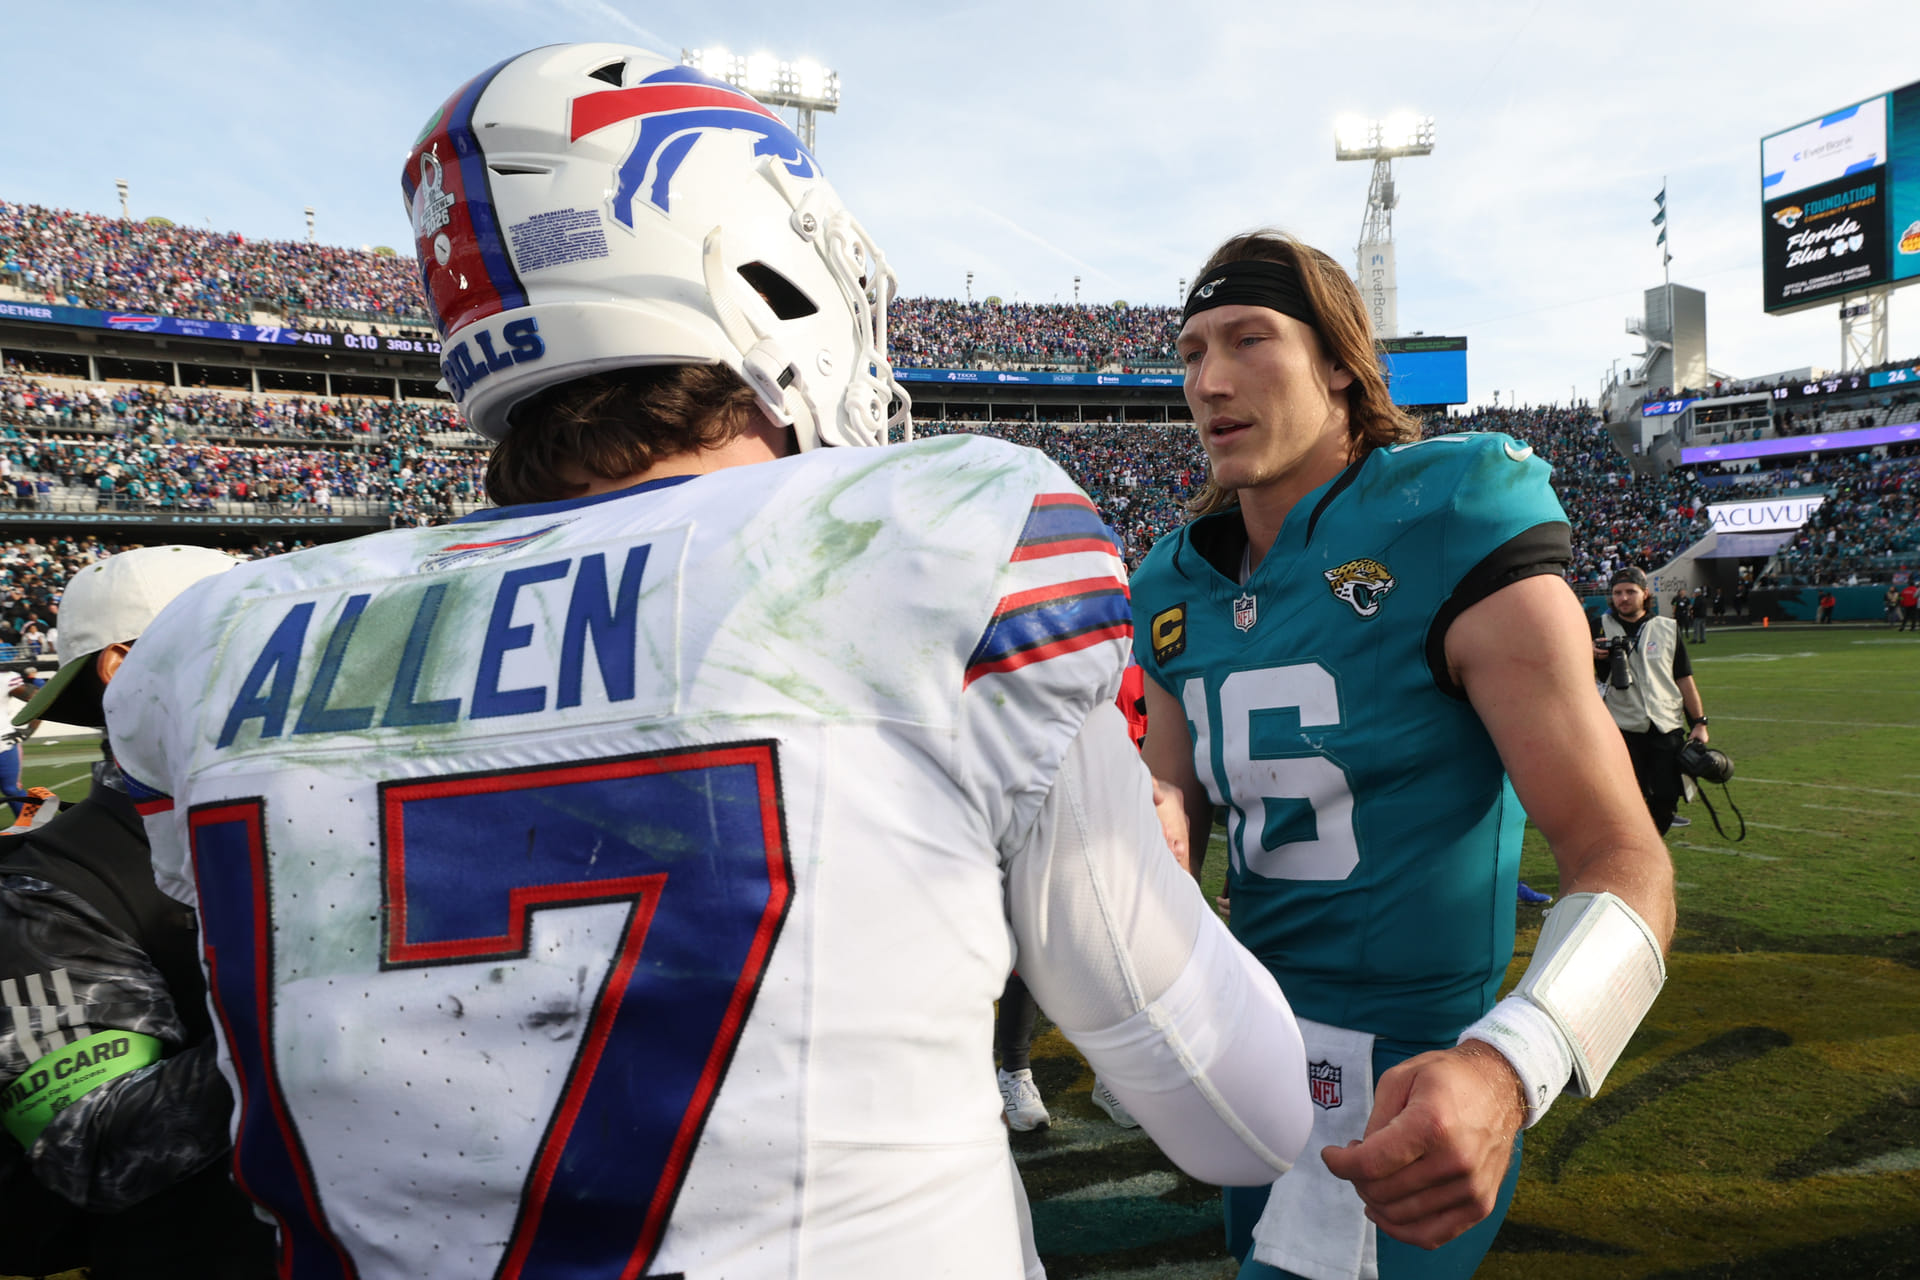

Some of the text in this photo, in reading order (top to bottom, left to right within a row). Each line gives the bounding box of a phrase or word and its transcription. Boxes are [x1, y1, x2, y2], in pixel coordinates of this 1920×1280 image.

[1804, 183, 1877, 216] FOUNDATION
[528, 207, 575, 220] WARNING
[1786, 217, 1861, 251] Florida
[1785, 246, 1828, 268] Blue
[1372, 268, 1386, 331] EverBank
[231, 329, 241, 340] 3
[255, 325, 281, 342] 27
[302, 332, 441, 354] 4TH 0:10 3RD & 12
[441, 316, 546, 403] BILLS
[1888, 370, 1907, 383] 24
[1773, 384, 1820, 399] 15 Q4
[1667, 400, 1683, 412] 27
[172, 516, 343, 524] INSURANCE
[1152, 608, 1183, 650] C
[1237, 610, 1253, 626] NFL
[215, 543, 652, 750] ALLEN
[1182, 662, 1360, 881] 16
[187, 738, 795, 1280] 17
[54, 1038, 130, 1080] CARD
[1312, 1079, 1339, 1104] NFL
